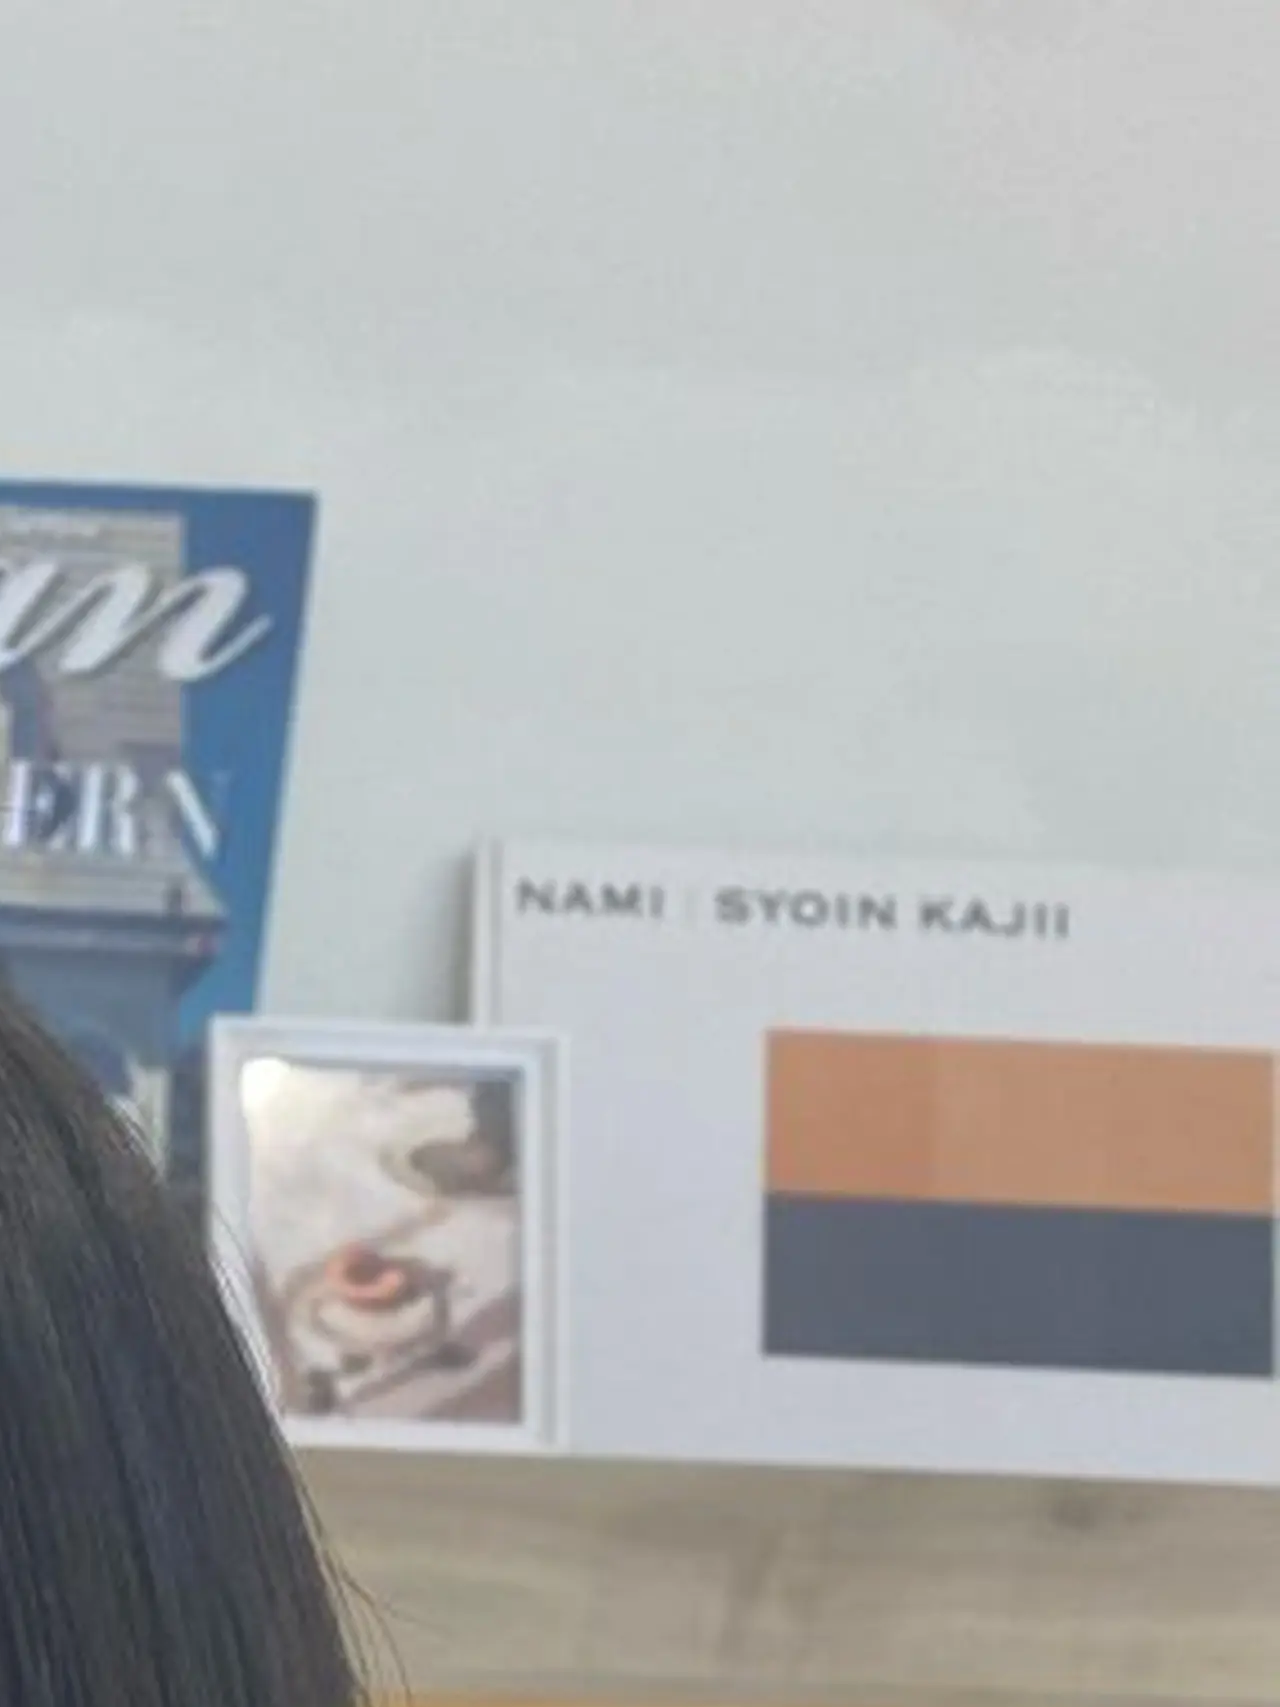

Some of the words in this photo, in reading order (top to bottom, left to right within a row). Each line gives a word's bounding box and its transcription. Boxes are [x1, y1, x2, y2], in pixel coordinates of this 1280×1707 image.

[514, 876, 666, 920] NAMI
[714, 884, 898, 931] SYOIN
[917, 896, 1071, 940] KAJII
